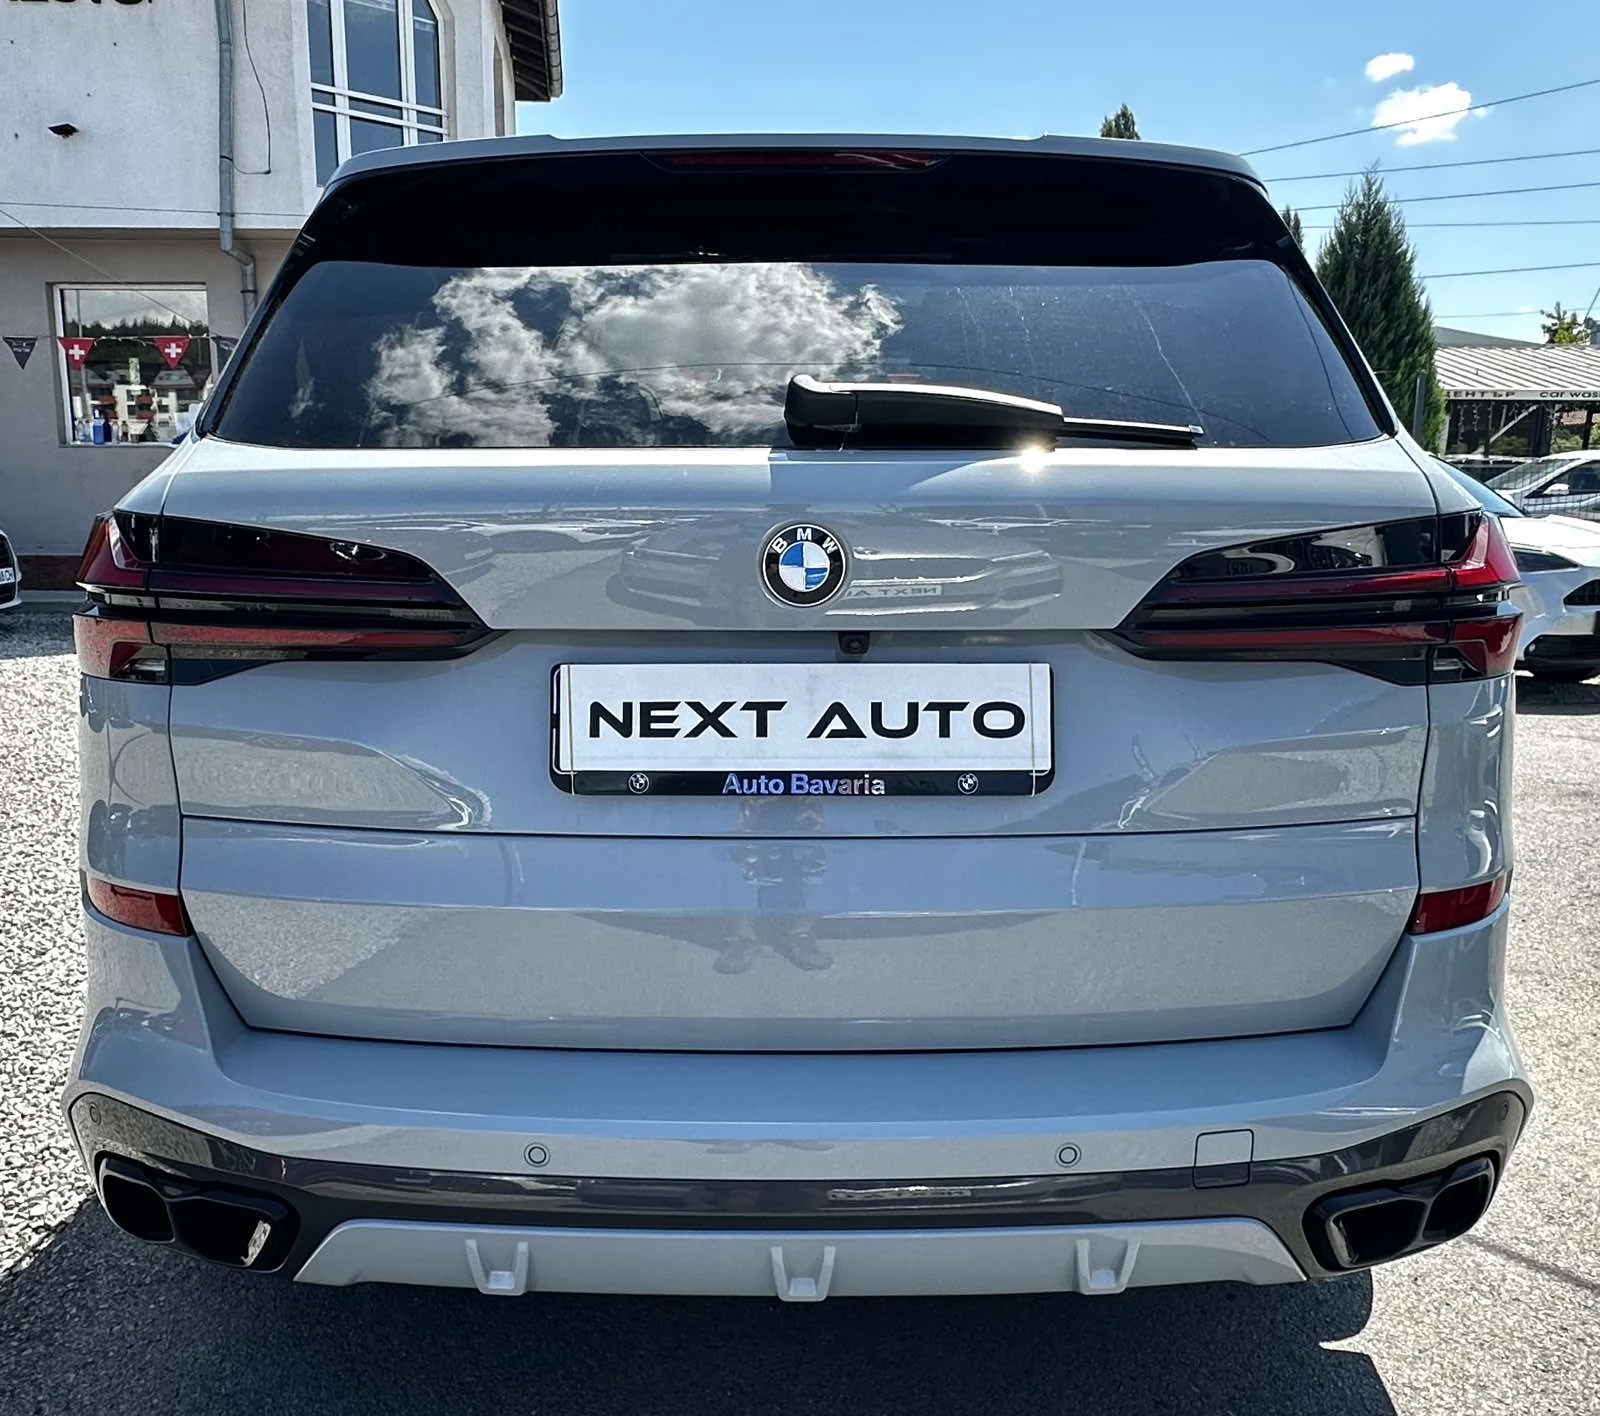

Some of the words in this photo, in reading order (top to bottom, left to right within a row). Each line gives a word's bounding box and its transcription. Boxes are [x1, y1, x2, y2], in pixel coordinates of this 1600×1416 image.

[771, 528, 838, 554] BMW
[588, 700, 788, 739] NEXT
[806, 700, 1026, 739] AUTO
[722, 772, 785, 795] Auto
[790, 772, 886, 795] Bavaria
